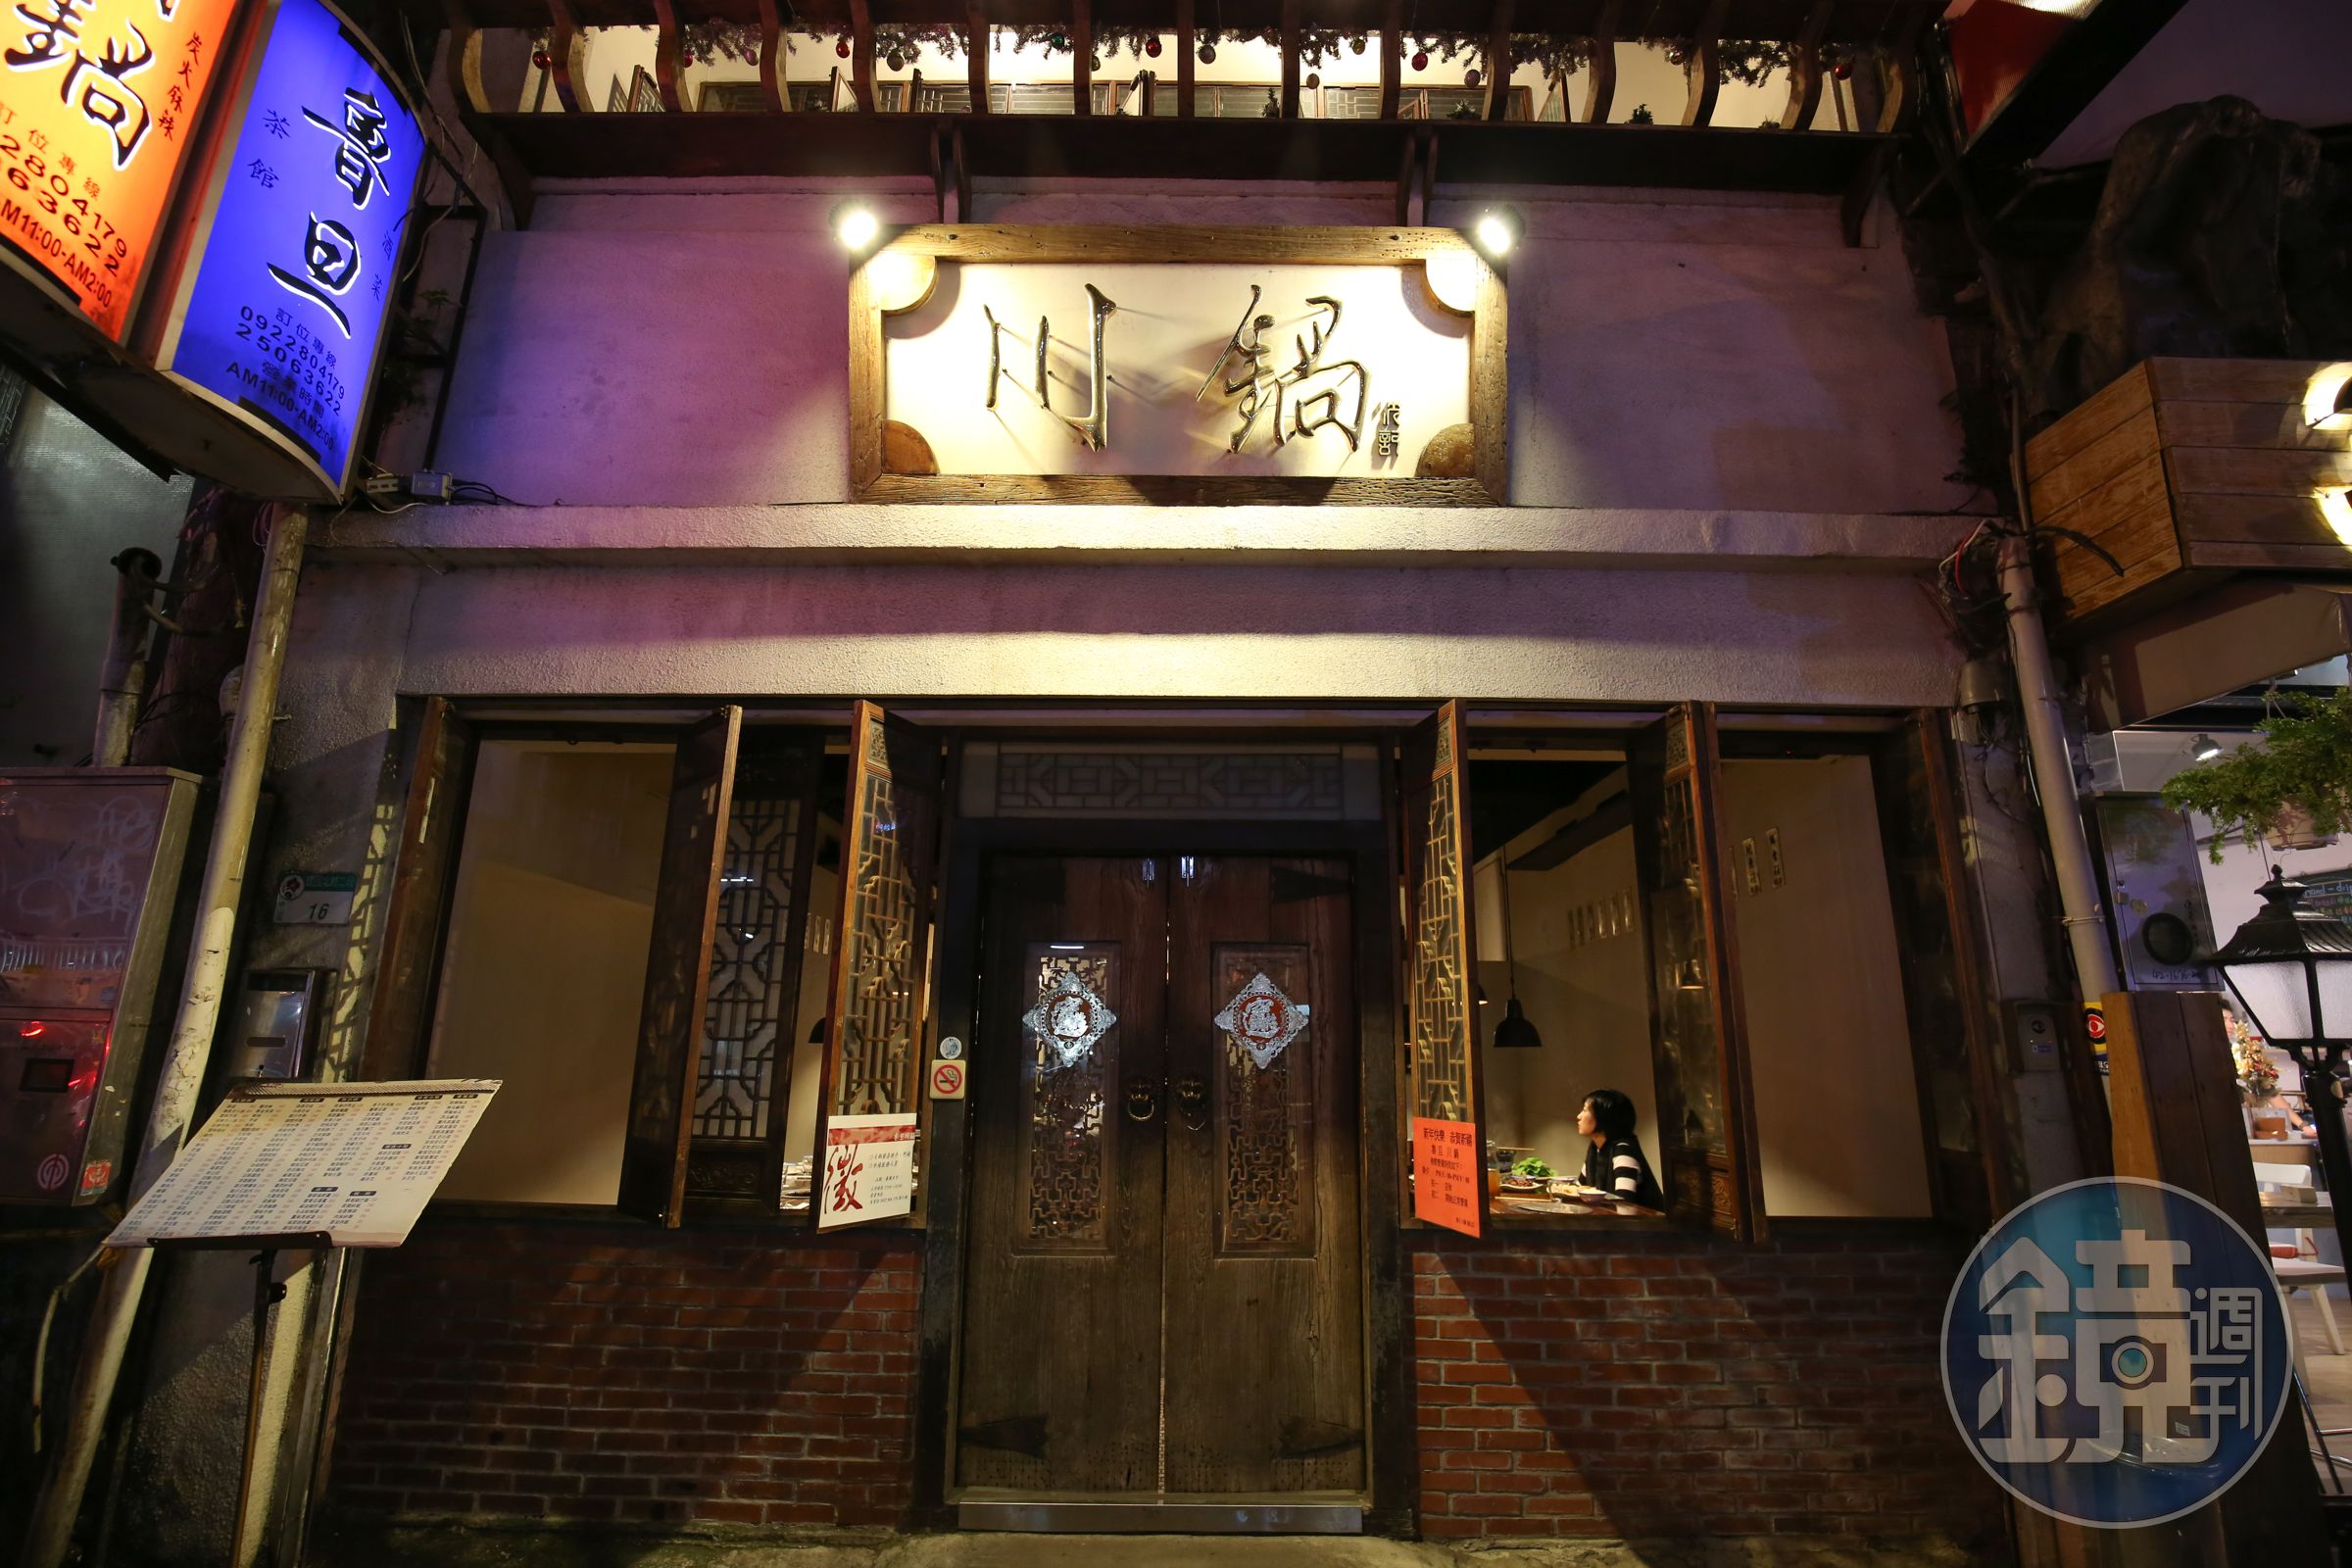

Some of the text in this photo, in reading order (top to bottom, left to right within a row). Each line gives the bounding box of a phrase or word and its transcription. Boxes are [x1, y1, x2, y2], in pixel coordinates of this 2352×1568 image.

[246, 109, 291, 191] 茶館
[240, 305, 346, 401] 0922804179
[275, 307, 338, 369] 訂位專線
[983, 282, 1373, 455] 川鍋
[225, 361, 336, 452] AM11:00-AM2:00
[309, 903, 330, 920] 16
